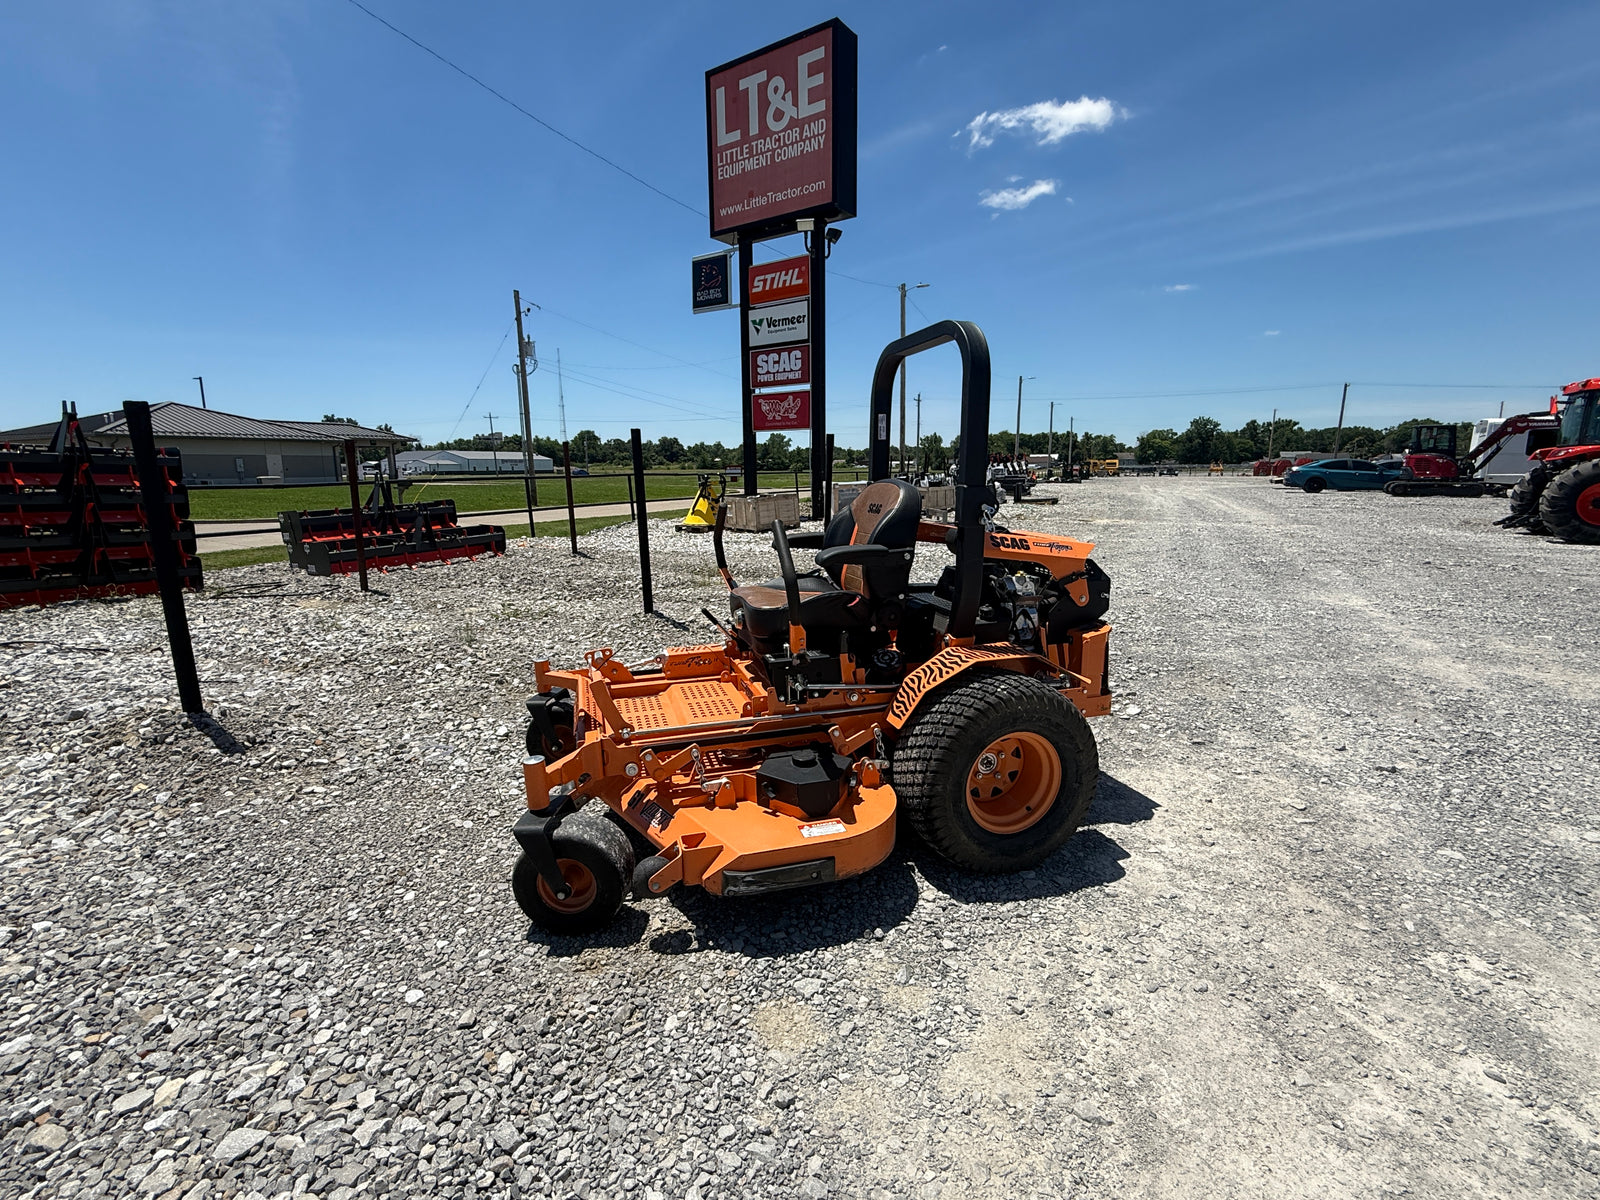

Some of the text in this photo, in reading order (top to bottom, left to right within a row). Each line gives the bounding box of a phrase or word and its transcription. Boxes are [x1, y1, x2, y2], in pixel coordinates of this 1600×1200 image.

[715, 46, 826, 146] LT&E
[717, 118, 826, 167] LITTLE TRACTOR AND
[718, 135, 826, 180] EQUIPMENT COMPANY
[719, 180, 826, 216] www.LittleTractor.com
[696, 289, 709, 297] BAD
[752, 268, 803, 293] STIHL
[766, 314, 806, 328] Vermeer
[757, 350, 802, 374] SCAG
[989, 534, 1030, 551] SCAG
